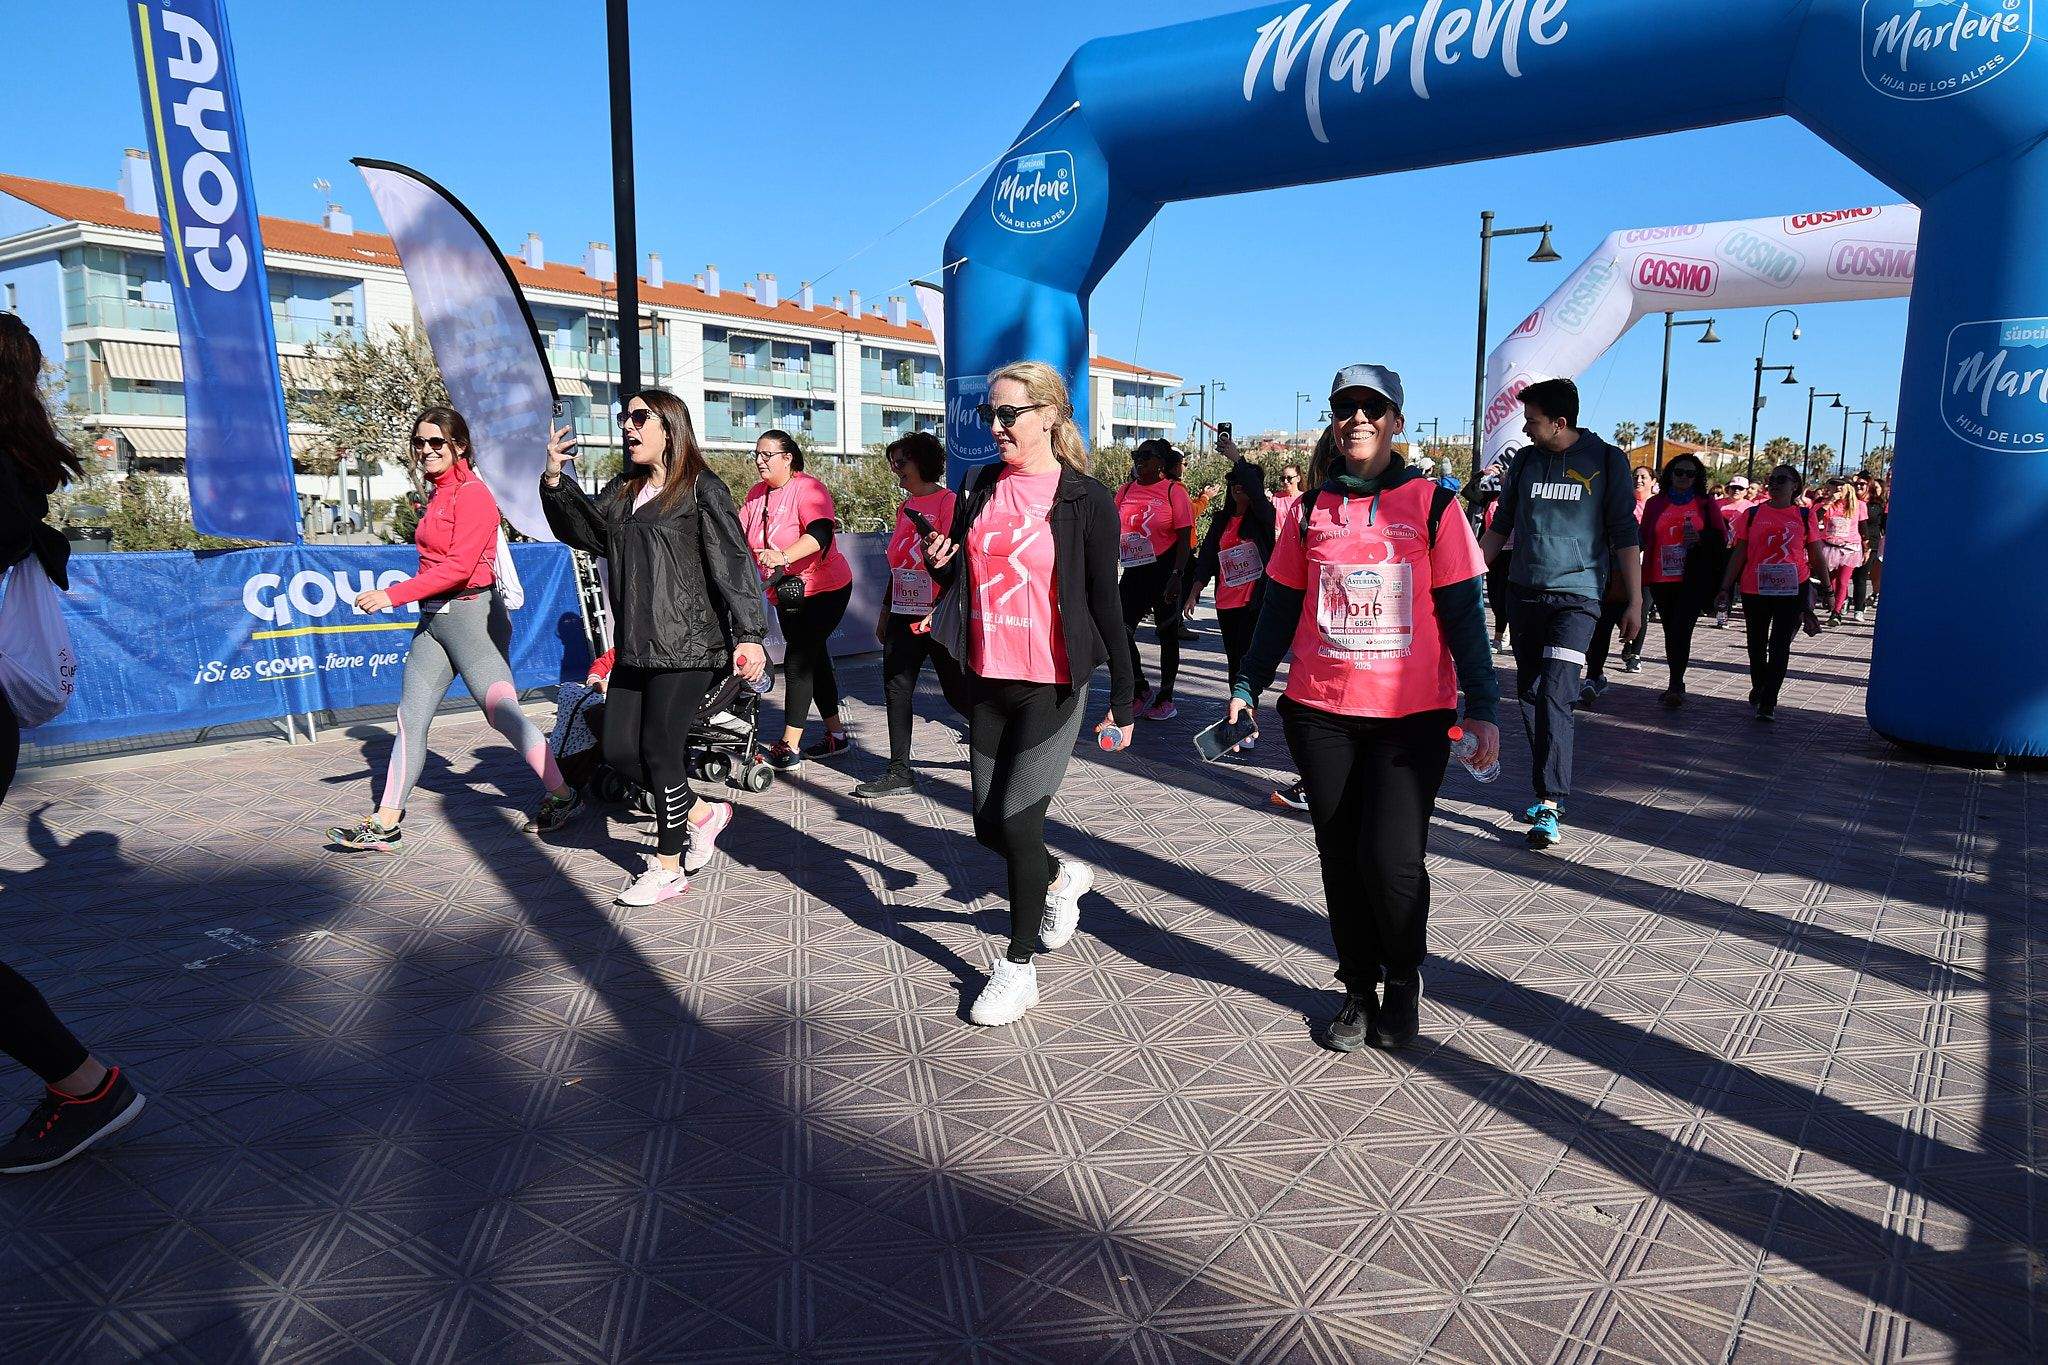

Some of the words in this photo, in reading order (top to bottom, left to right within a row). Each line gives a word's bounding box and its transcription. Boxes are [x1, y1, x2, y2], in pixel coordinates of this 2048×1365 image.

[1872, 2, 2021, 72] Marlene
[1243, 0, 1568, 143] Marlene
[1879, 73, 1905, 91] HIJA
[1908, 82, 1927, 93] DE
[1929, 78, 1957, 92] LOS
[1961, 54, 2006, 84] ALPES
[162, 9, 249, 292] GOYA
[997, 171, 1069, 214] Marlene
[999, 211, 1013, 226] HIJA
[1014, 220, 1026, 229] DE
[1026, 220, 1042, 229] LOS
[1044, 208, 1066, 226] ALPES
[1723, 230, 1798, 283] COSMO
[1836, 244, 1917, 279] COSMO
[1639, 258, 1711, 293] COSMO
[1557, 265, 1614, 328] COSMO
[1956, 414, 1984, 438] HIJA
[1987, 429, 2009, 443] DE
[2012, 433, 2045, 444] LOS
[1530, 482, 1583, 501] PUMA
[1348, 603, 1383, 617] 016
[230, 665, 251, 681] es
[255, 654, 315, 677] GOYA
[368, 653, 398, 677] que
